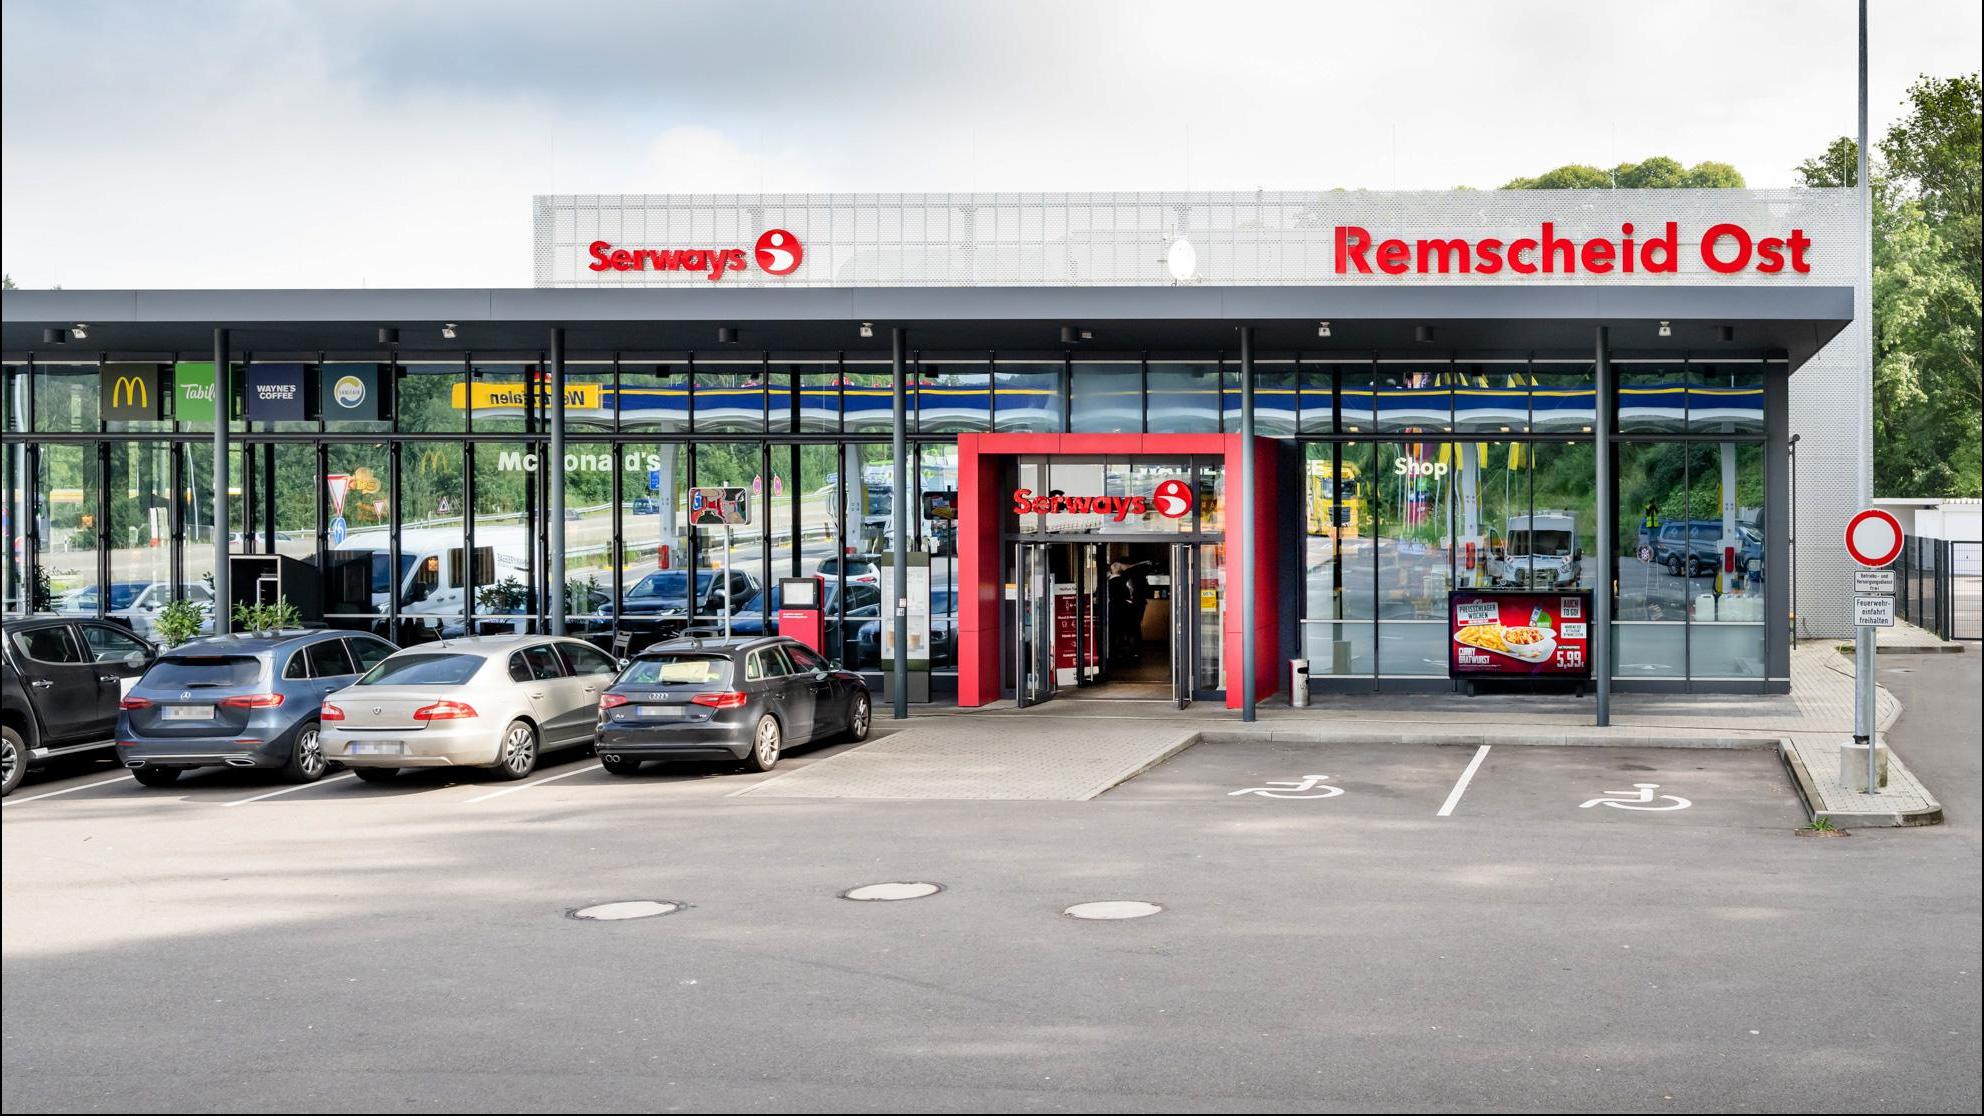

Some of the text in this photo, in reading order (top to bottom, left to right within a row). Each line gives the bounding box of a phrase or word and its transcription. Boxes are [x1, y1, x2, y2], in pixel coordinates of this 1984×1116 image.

[1334, 221, 1811, 275] Remscheid Ost
[588, 240, 746, 281] Serways
[259, 392, 294, 400] COFFEE
[498, 451, 661, 472] Mconad's
[1394, 457, 1448, 480] Shop
[1013, 488, 1147, 522] Serways
[1856, 599, 1890, 607] Feuerwehr-
